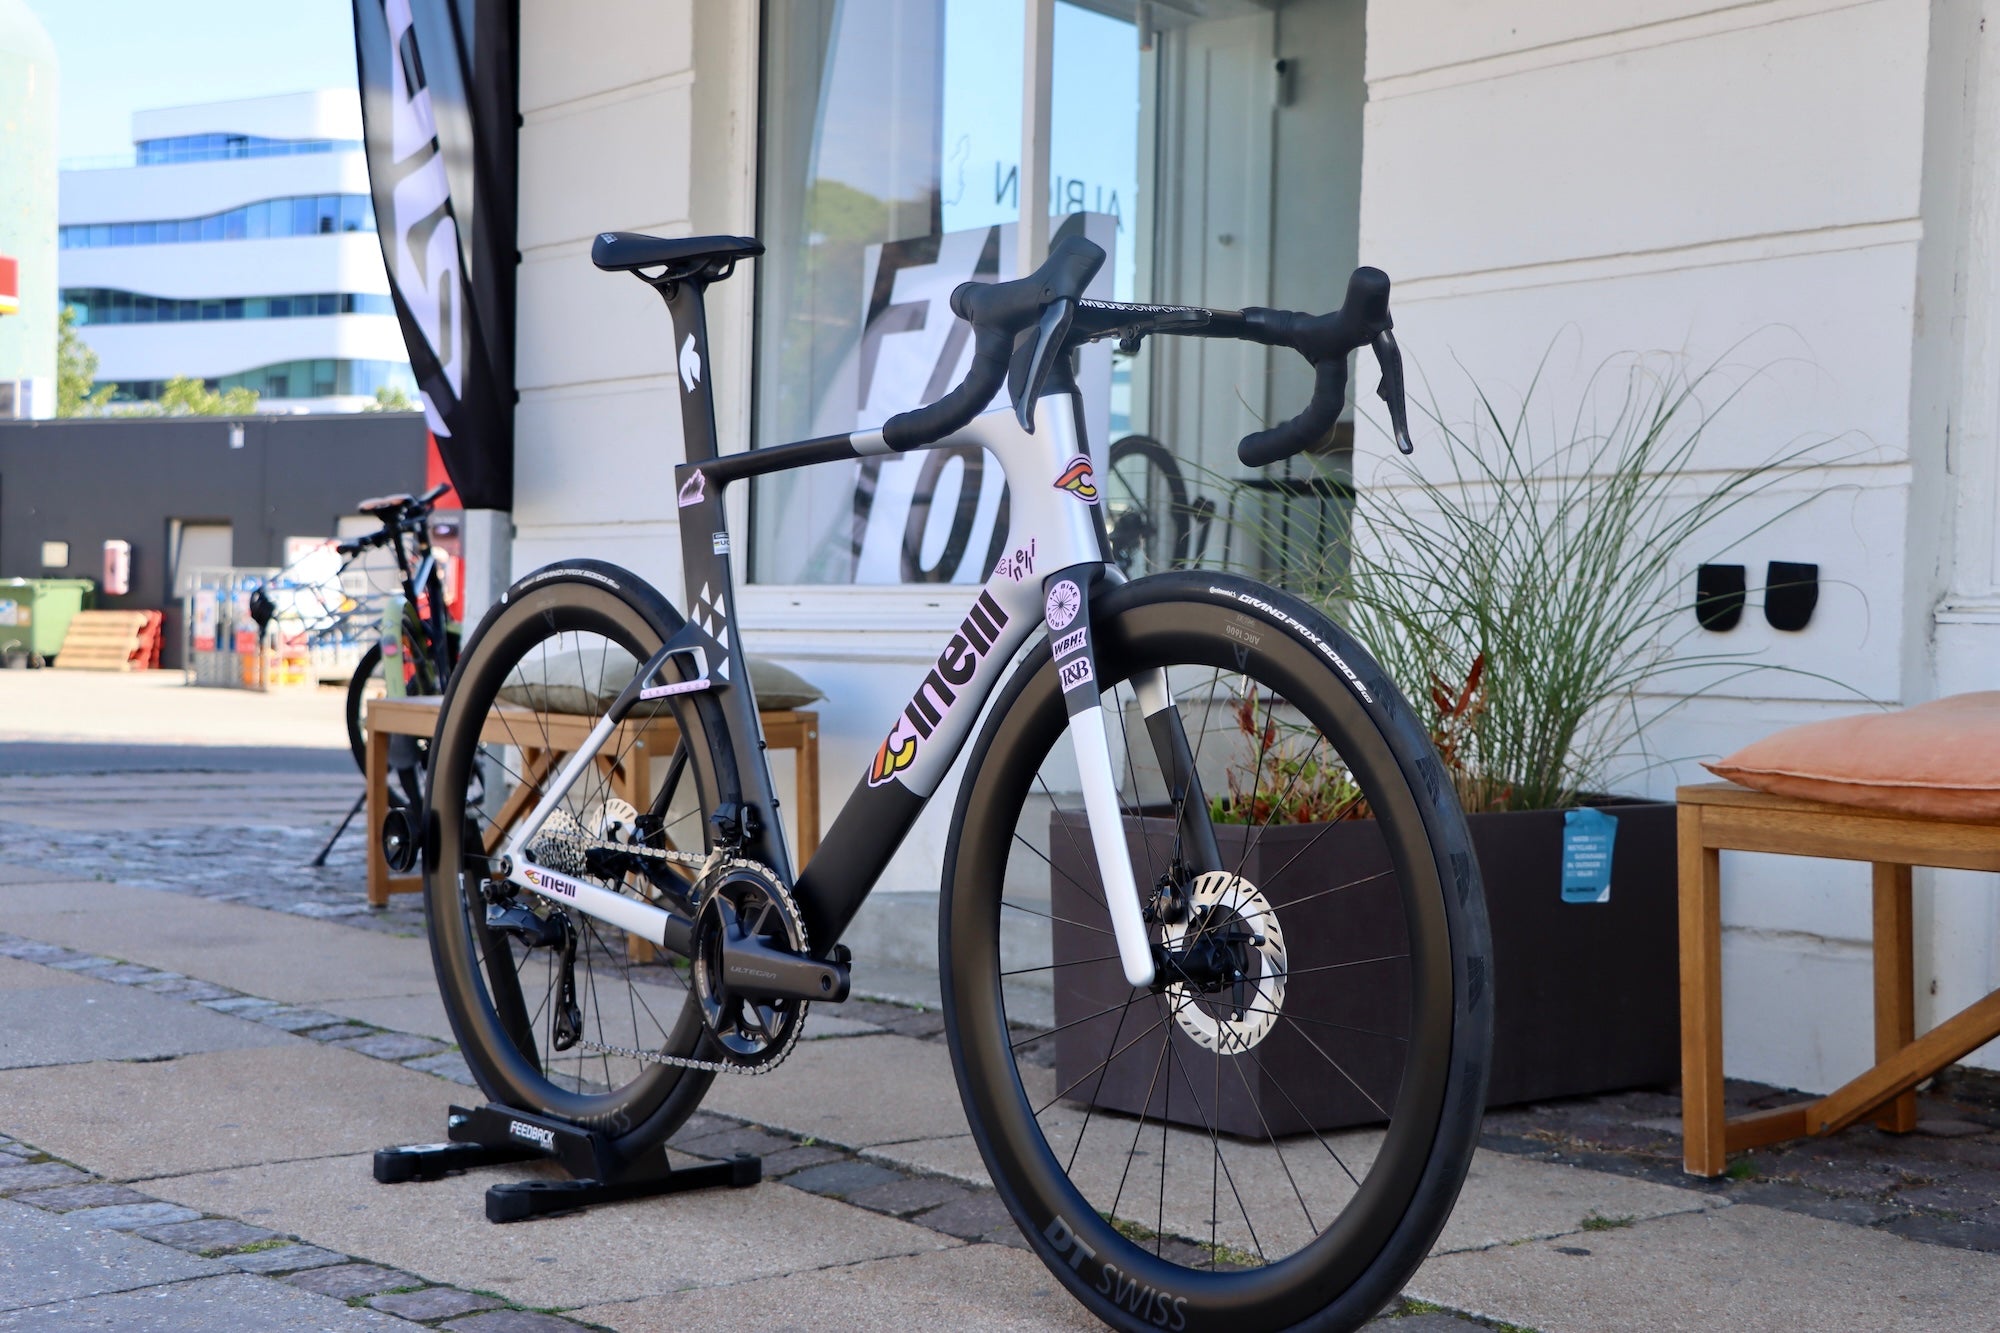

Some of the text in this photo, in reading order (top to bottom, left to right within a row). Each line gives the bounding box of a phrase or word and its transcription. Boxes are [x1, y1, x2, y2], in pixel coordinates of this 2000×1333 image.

[1060, 583, 1078, 598] BIKE
[1054, 631, 1083, 655] WBH!
[1226, 624, 1261, 645] ARC 1600
[1237, 593, 1288, 621] GRAND
[1285, 616, 1322, 644] PRIX
[1317, 642, 1357, 680] 5000
[730, 965, 777, 980] ULTEGRA
[509, 1120, 555, 1145] FEEDBACK
[1043, 1214, 1188, 1332] DT SWISS
